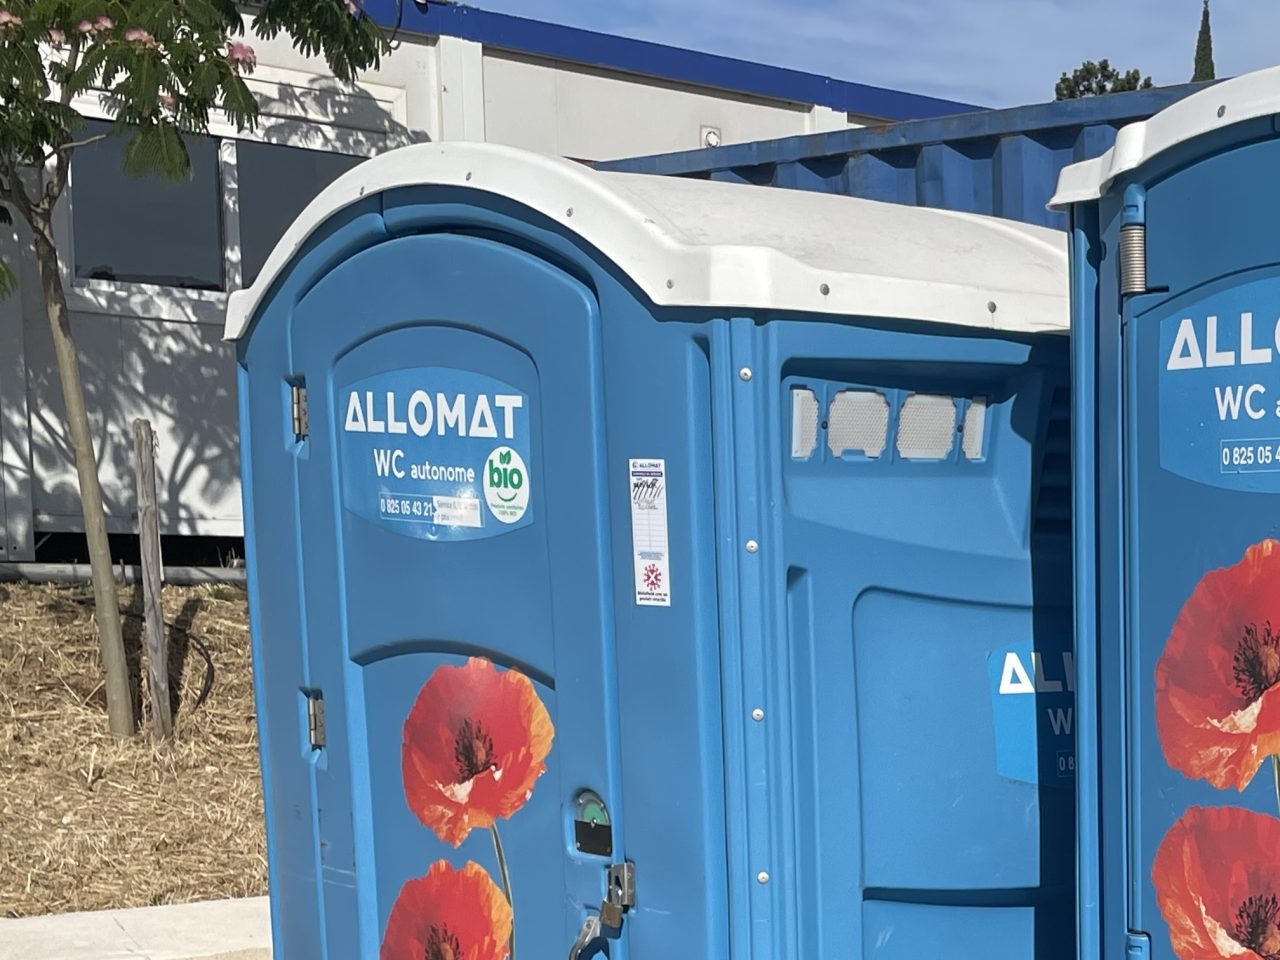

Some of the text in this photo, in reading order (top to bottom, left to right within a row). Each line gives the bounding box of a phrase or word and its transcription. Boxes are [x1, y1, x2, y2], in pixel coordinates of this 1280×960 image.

[345, 390, 523, 439] ALLOMAT
[1215, 383, 1266, 421] WC
[374, 448, 475, 483] WC autonome
[1222, 447, 1230, 465] 0
[1232, 446, 1254, 465] 825
[1257, 446, 1272, 464] 05
[489, 459, 523, 489] bio
[380, 499, 386, 513] 0
[387, 499, 400, 514] 825
[401, 500, 411, 515] 05
[412, 501, 422, 516] 43
[424, 502, 433, 516] 21
